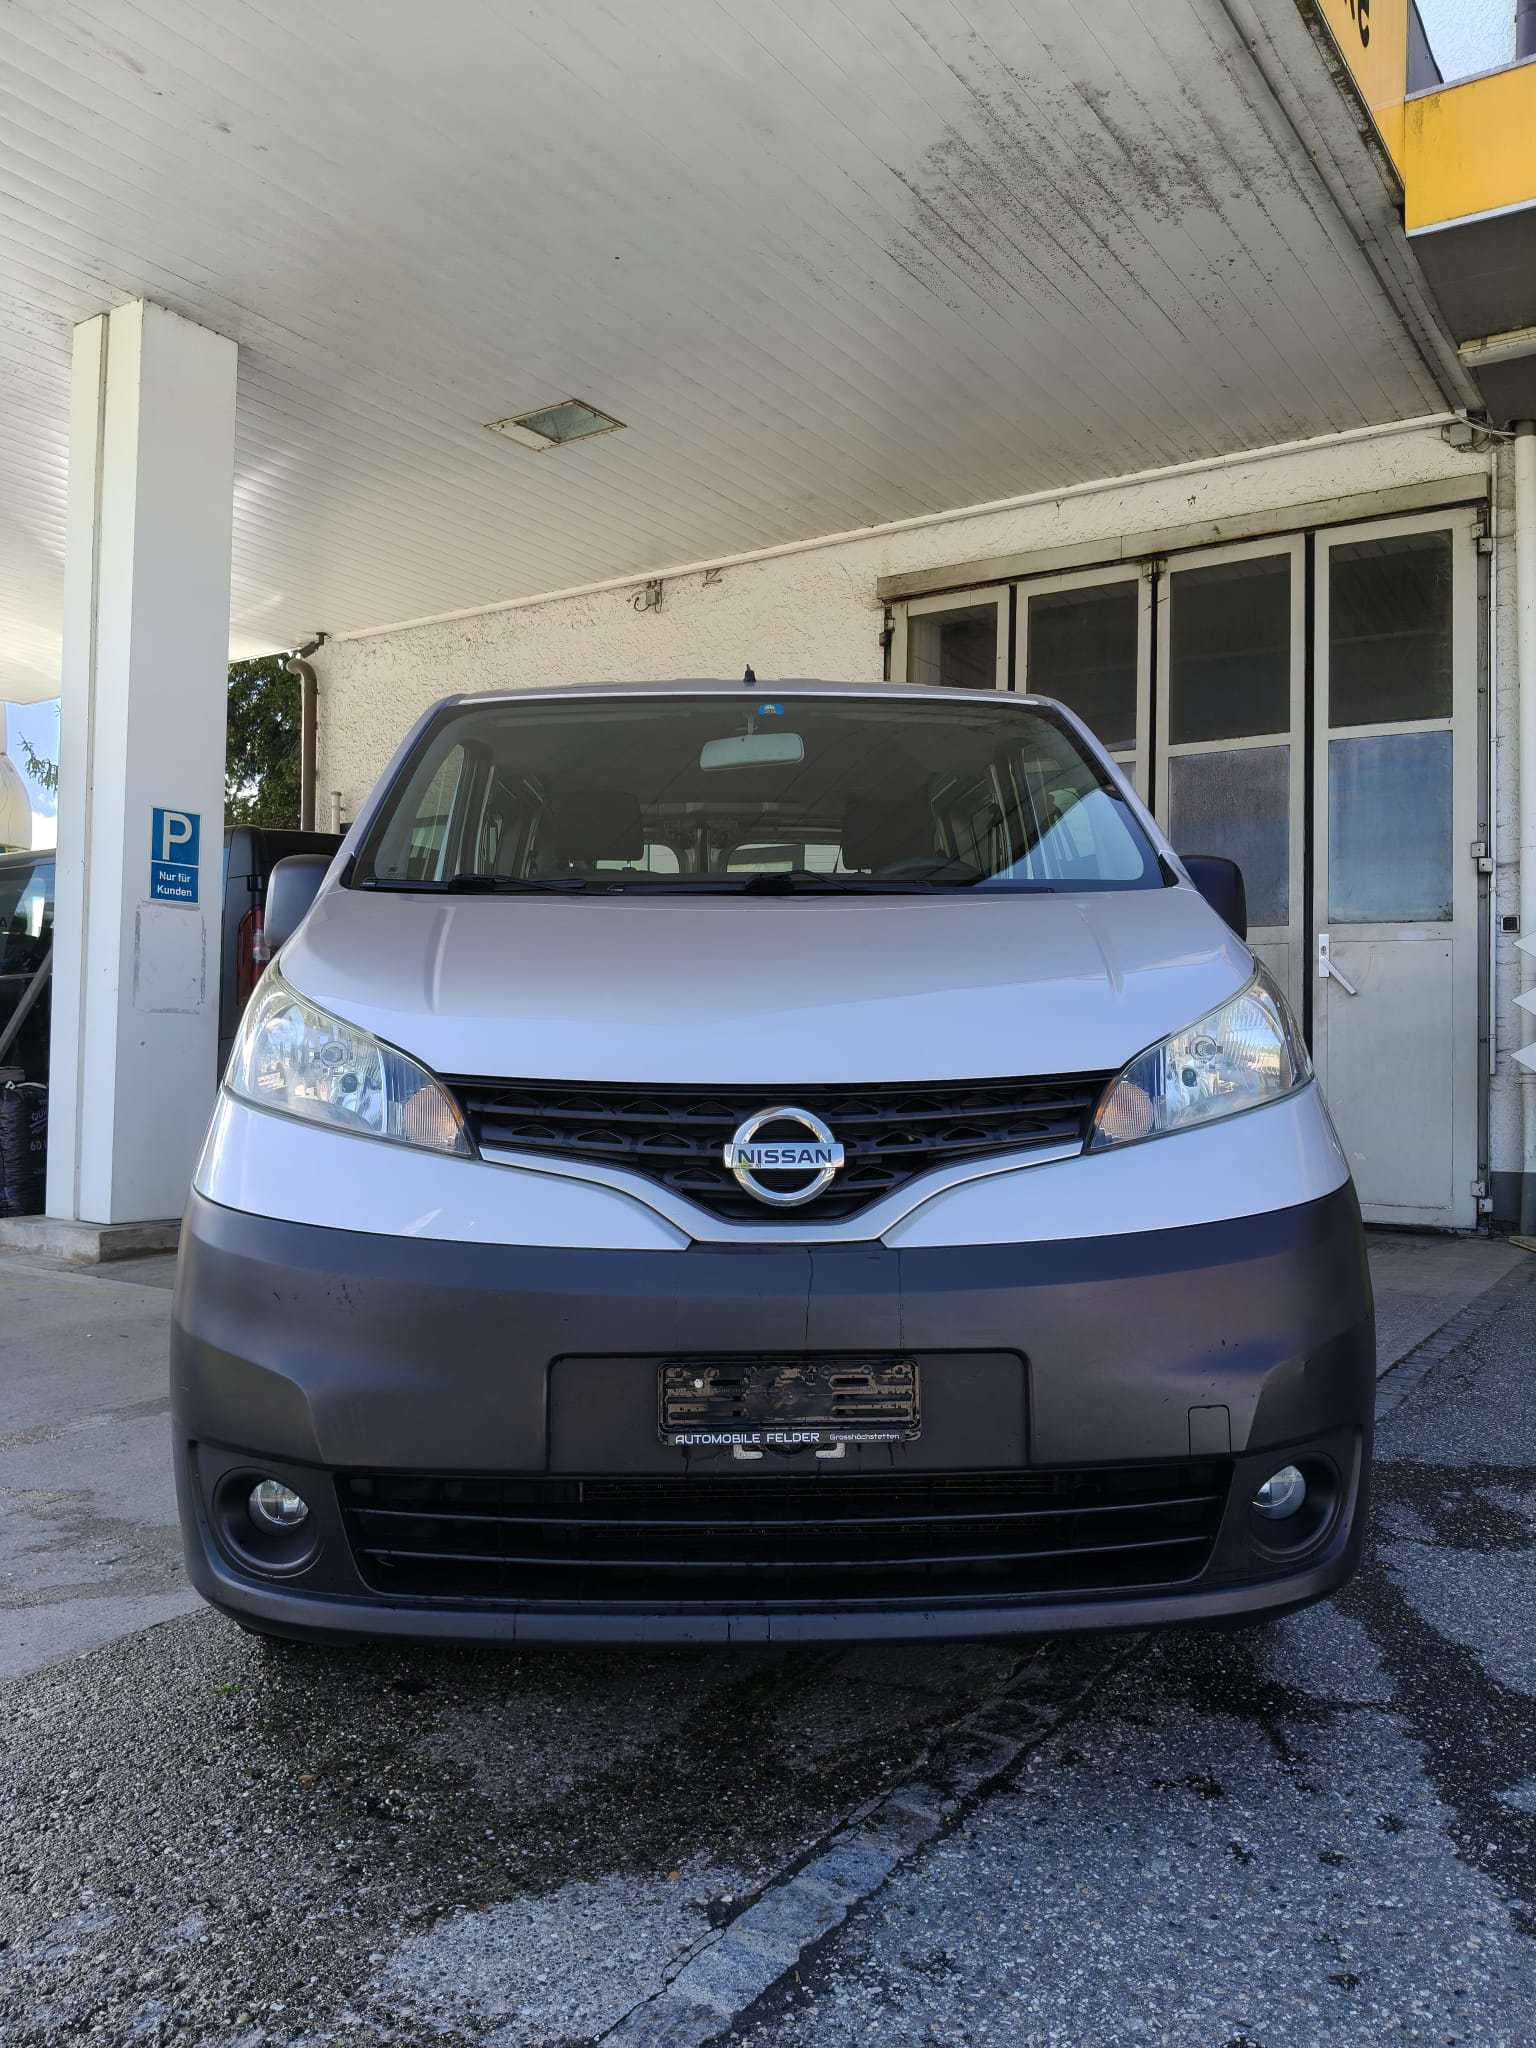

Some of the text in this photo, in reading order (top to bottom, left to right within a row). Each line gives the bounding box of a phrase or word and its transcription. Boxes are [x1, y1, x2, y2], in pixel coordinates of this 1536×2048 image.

[162, 811, 193, 861] P
[159, 871, 192, 883] Nur für
[157, 885, 192, 897] Kunden
[738, 1149, 832, 1164] NISSAN
[675, 1433, 761, 1445] AUTOMOBILE
[766, 1432, 820, 1443] FELDER
